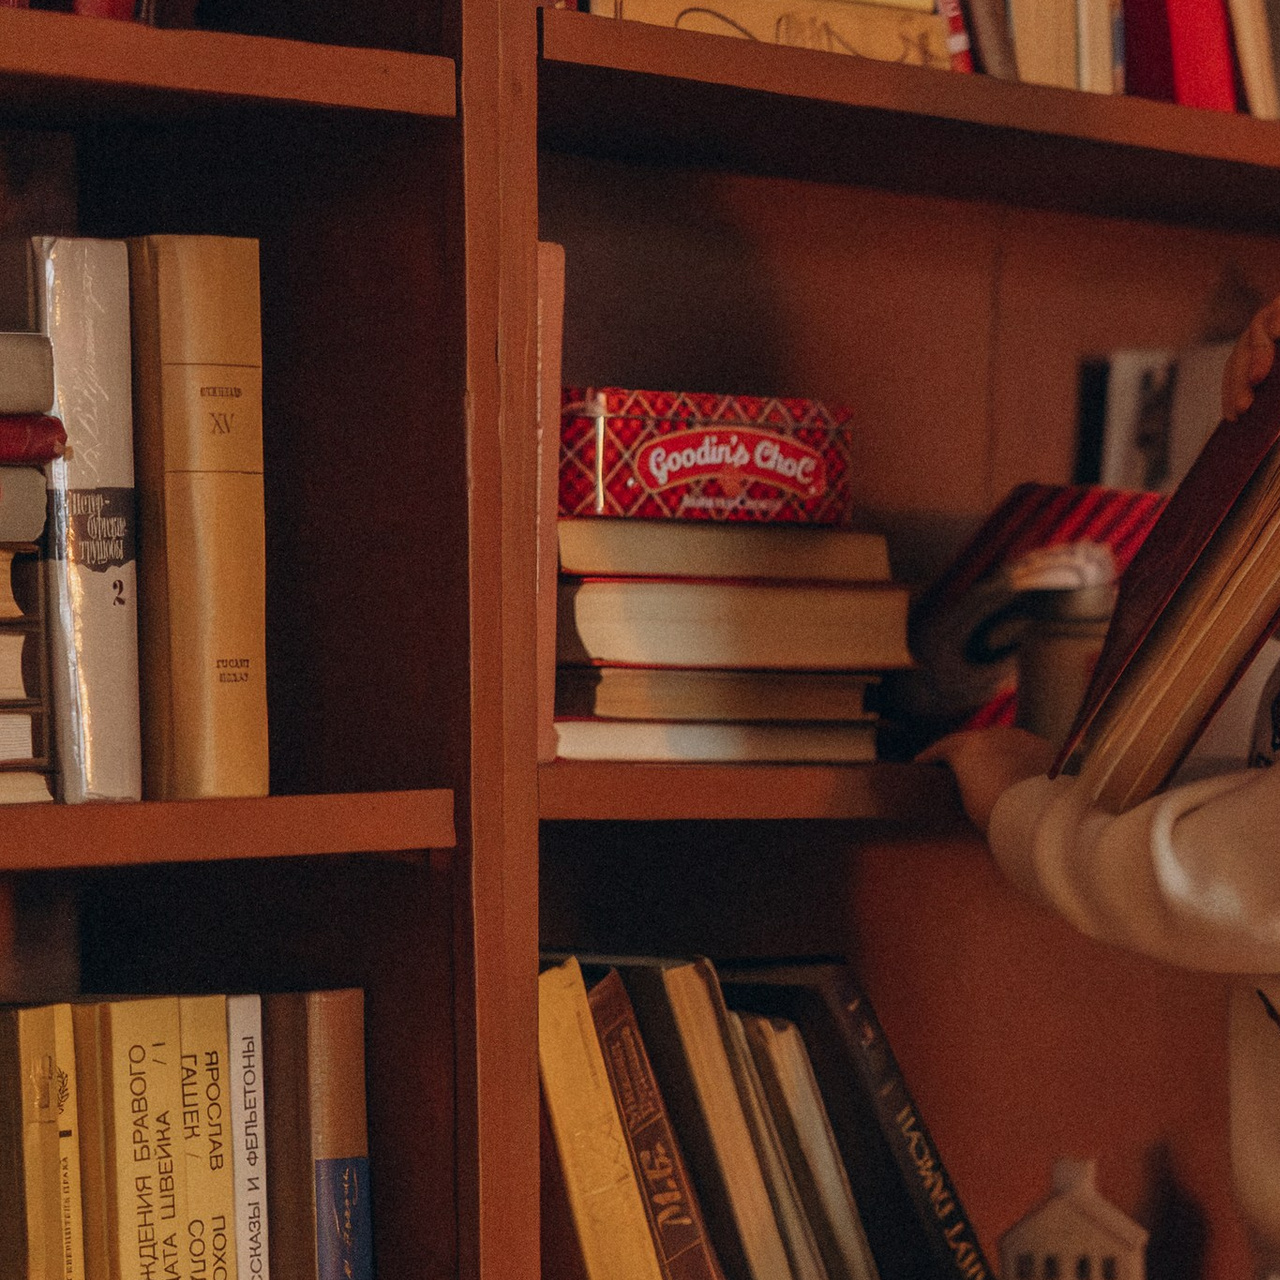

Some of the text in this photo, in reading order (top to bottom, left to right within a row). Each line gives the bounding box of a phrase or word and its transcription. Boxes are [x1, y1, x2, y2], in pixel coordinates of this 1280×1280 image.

[209, 413, 236, 435] XV
[648, 434, 750, 486] Goodin's
[112, 578, 126, 607] 2
[129, 1044, 151, 1169] БРАВОГО
[180, 1053, 200, 1141] ГАШЕК
[205, 1050, 225, 1173] ЯРОСЛАВ
[241, 1034, 262, 1170] ФЕЛЬЕТОНЫ
[157, 1110, 175, 1220] ШВЕЙКА
[246, 1185, 261, 1199] И
